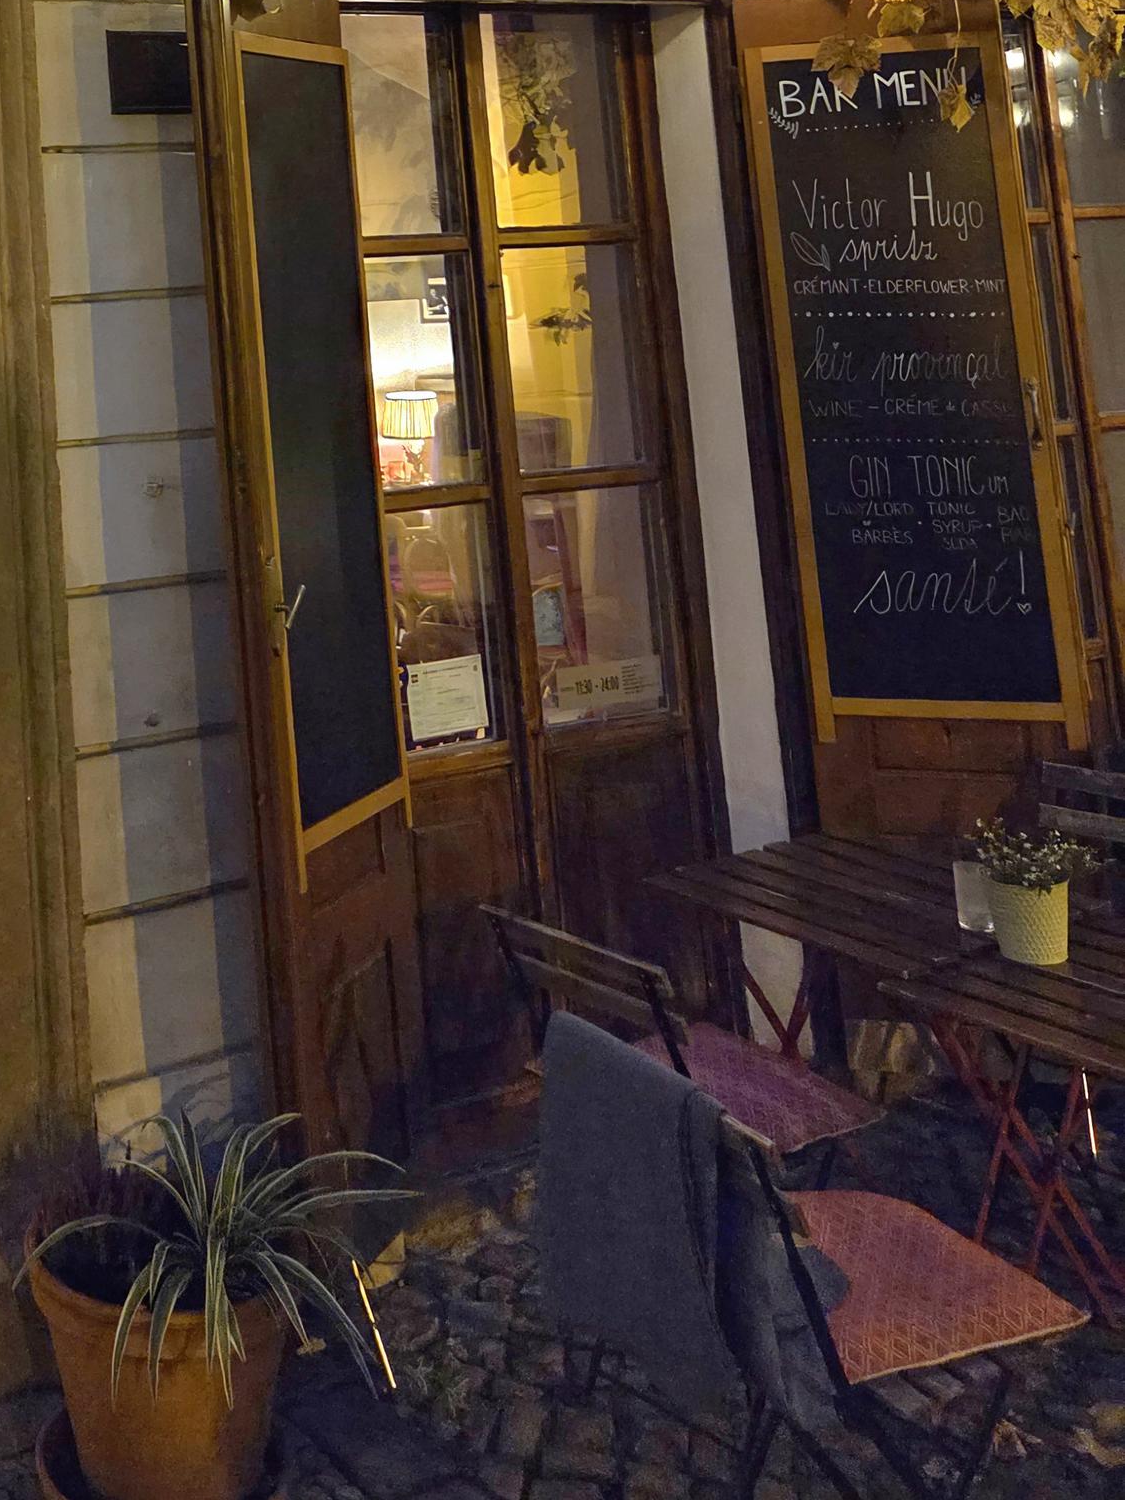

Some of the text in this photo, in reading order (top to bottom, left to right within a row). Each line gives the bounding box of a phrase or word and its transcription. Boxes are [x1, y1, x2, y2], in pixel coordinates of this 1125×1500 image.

[778, 66, 967, 118] BAR MENU
[792, 171, 984, 241] Victor Hugo
[809, 399, 863, 418] WINE
[849, 455, 891, 498] GIN
[926, 501, 976, 516] TONIC
